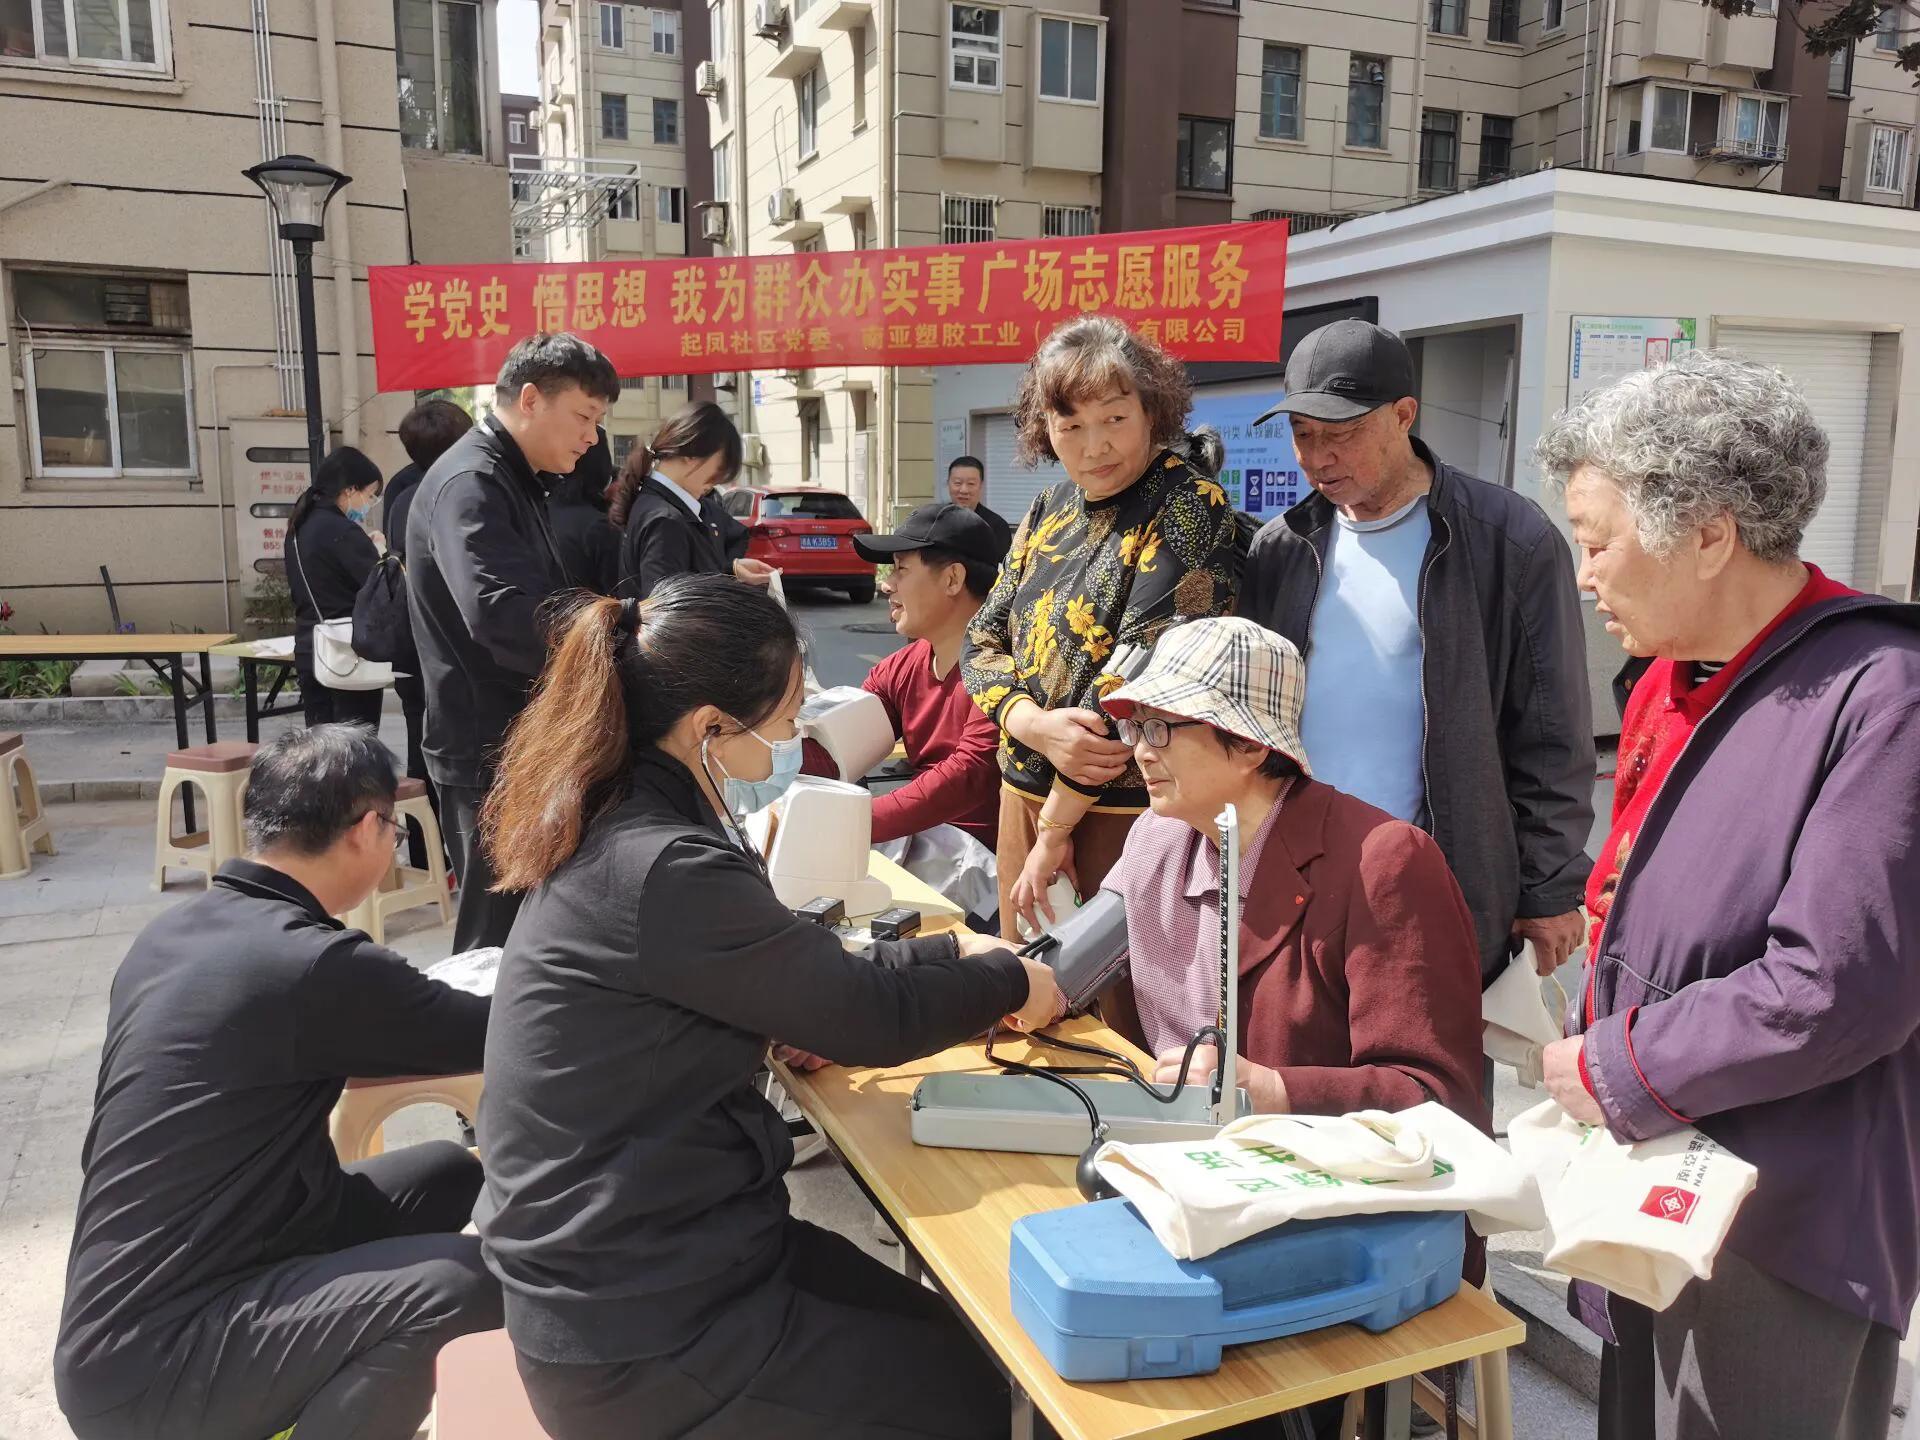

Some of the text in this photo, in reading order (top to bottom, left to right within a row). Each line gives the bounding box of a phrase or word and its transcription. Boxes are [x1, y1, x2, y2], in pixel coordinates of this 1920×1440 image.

[403, 276, 511, 344] 学党史
[532, 268, 647, 334] 悟思想
[1693, 1164, 1708, 1187] NAN
